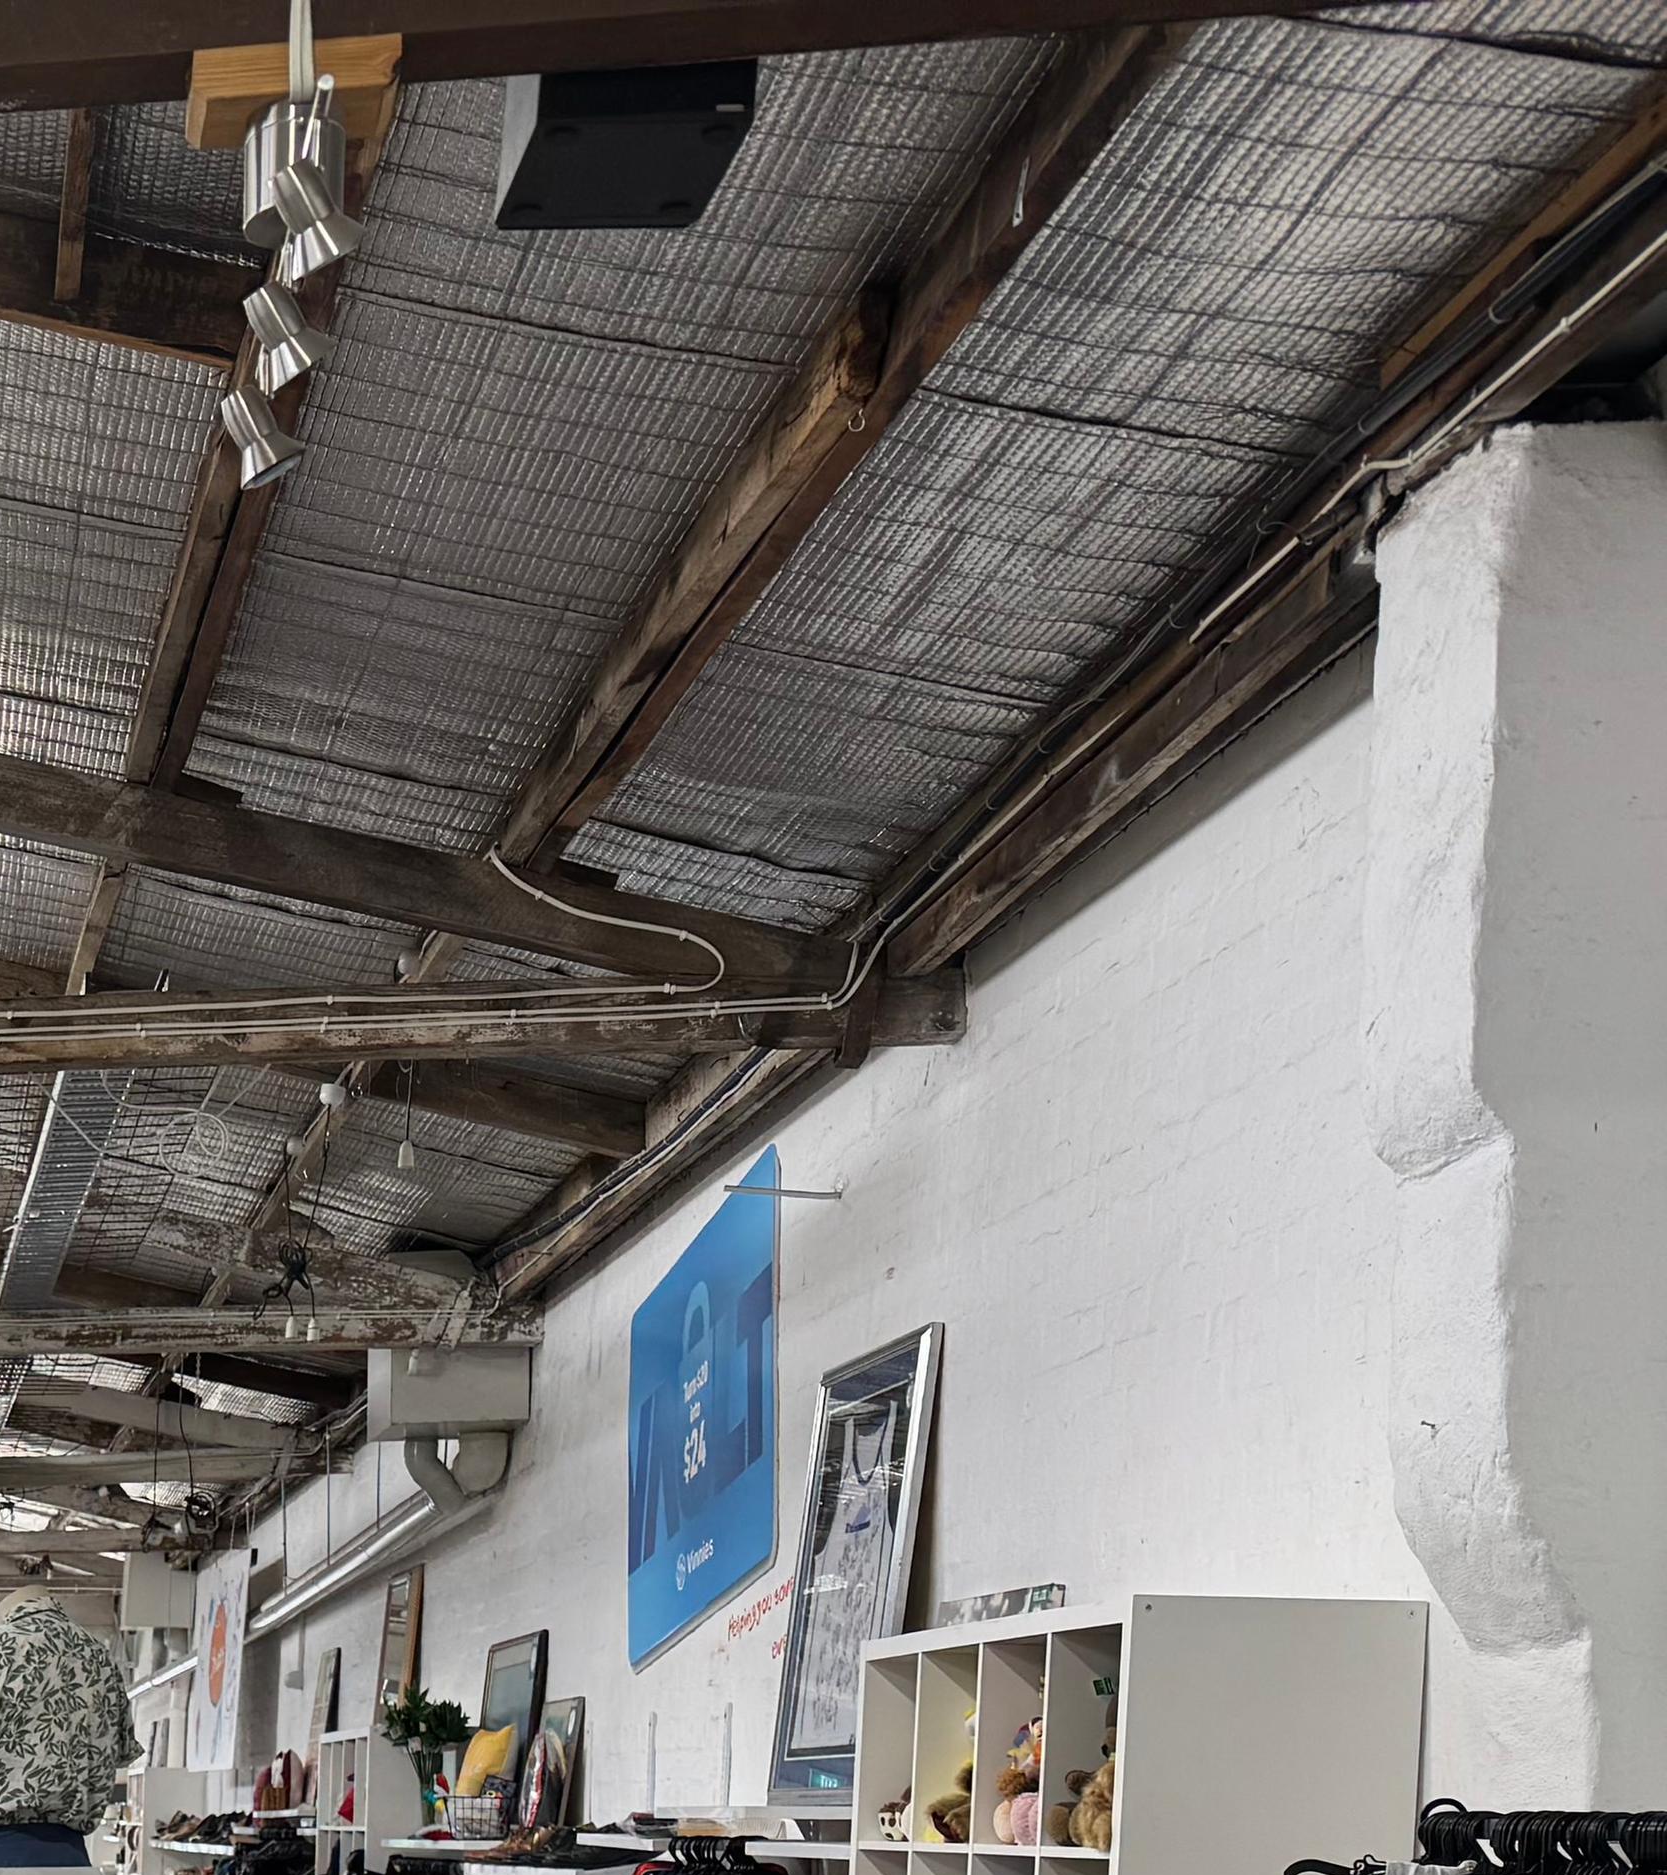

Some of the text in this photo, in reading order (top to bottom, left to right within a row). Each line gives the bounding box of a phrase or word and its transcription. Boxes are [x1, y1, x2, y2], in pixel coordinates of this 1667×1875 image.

[696, 1359, 709, 1391] $20
[683, 1426, 707, 1485] $24
[686, 1537, 715, 1576] Vinnies
[728, 1604, 756, 1641] Helping
